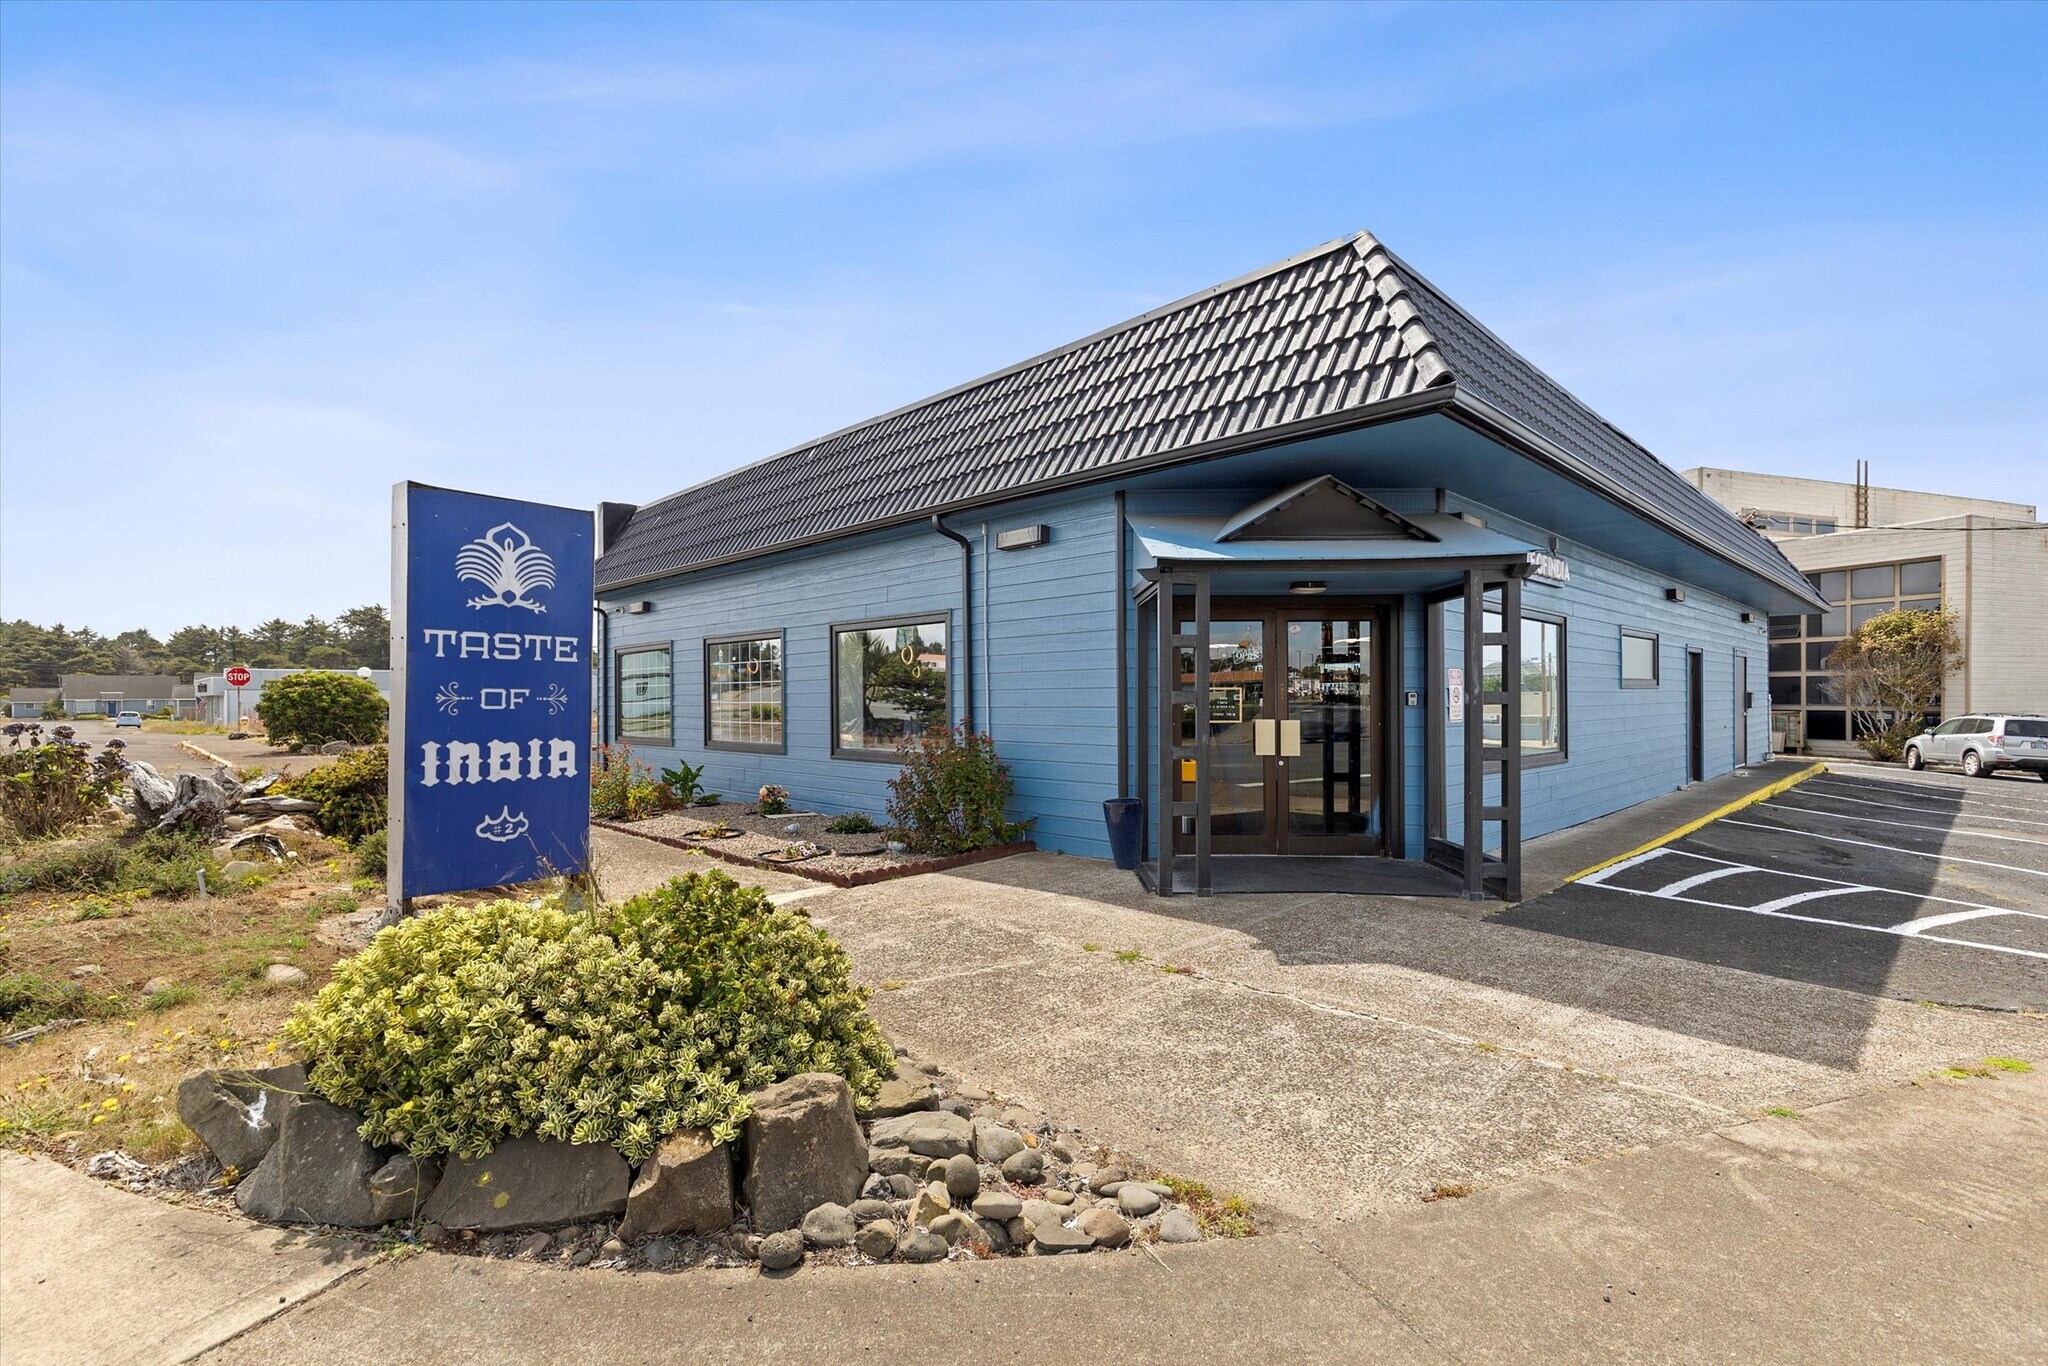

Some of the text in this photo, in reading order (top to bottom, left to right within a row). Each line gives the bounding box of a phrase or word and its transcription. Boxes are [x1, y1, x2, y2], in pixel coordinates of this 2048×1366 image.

[423, 629, 579, 662] TASTE
[227, 673, 250, 681] STOP
[480, 688, 530, 709] OF
[420, 737, 578, 787] INDIA
